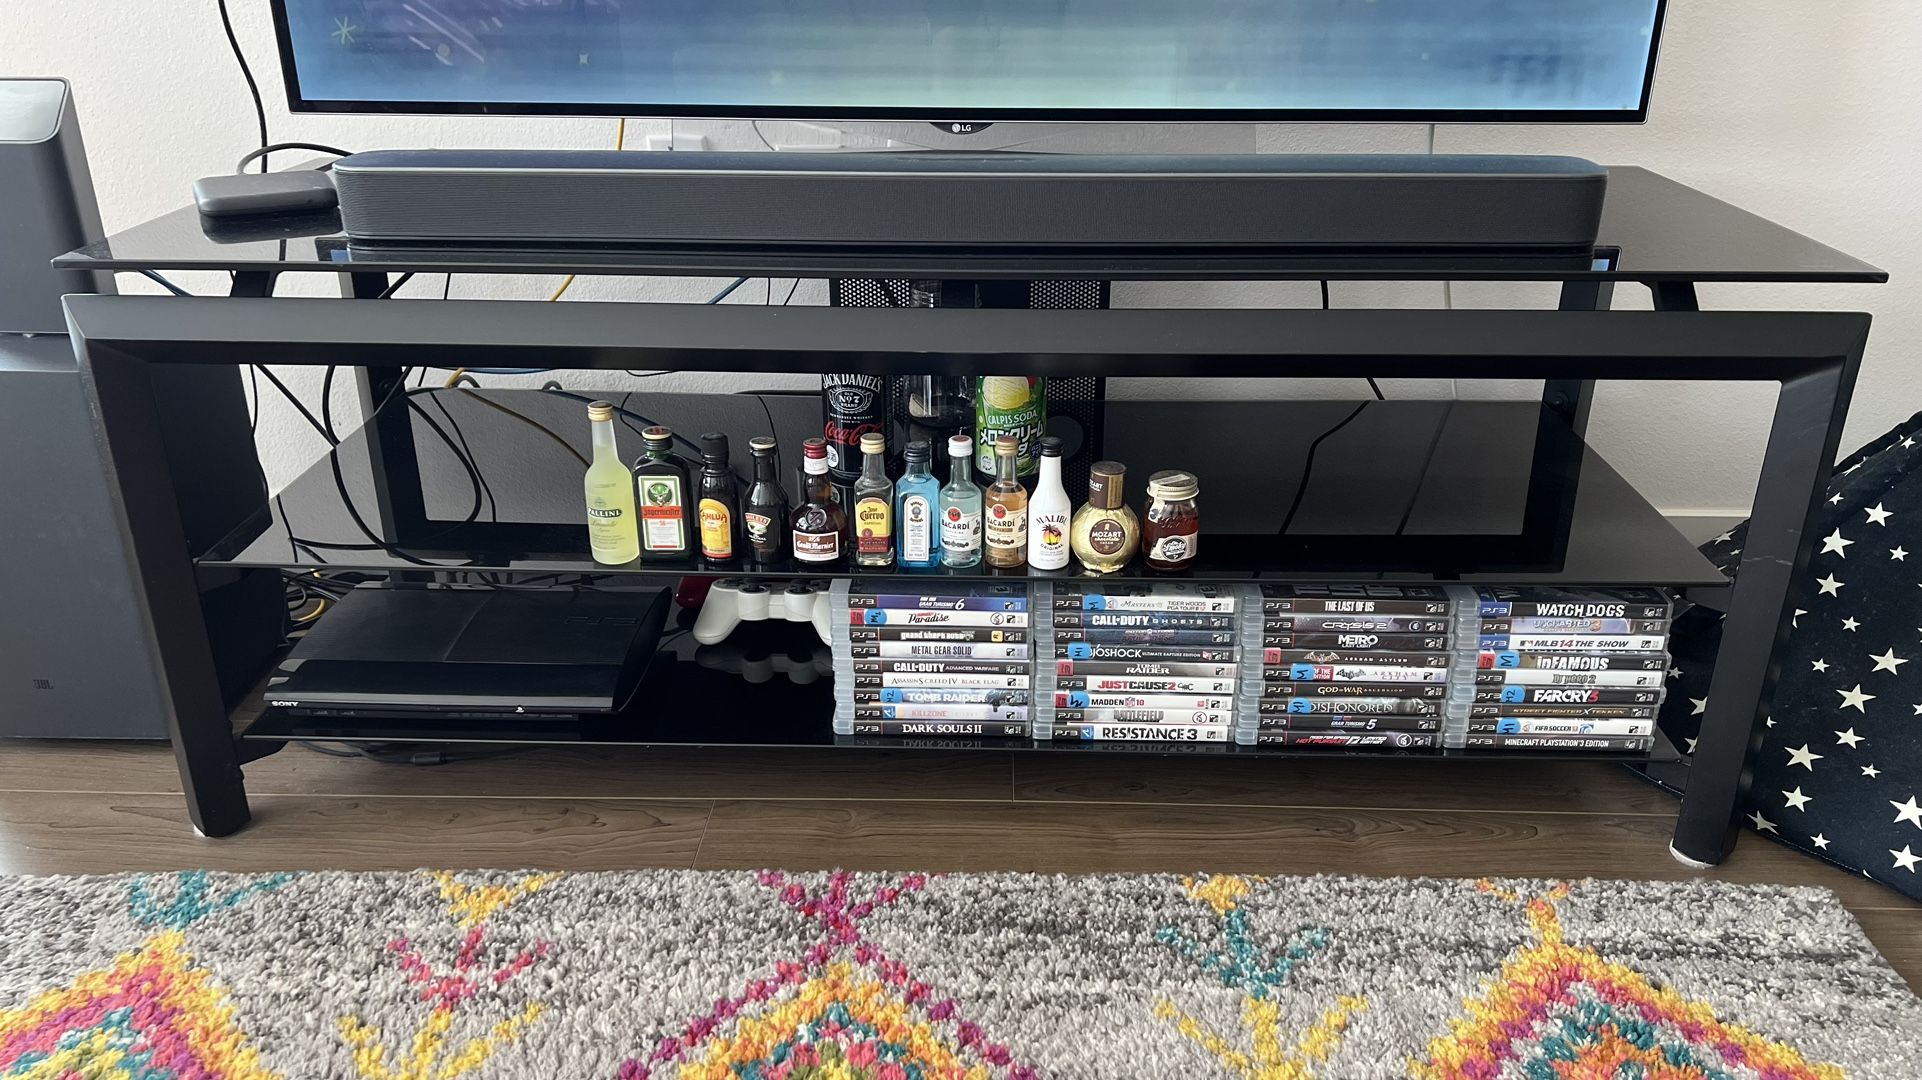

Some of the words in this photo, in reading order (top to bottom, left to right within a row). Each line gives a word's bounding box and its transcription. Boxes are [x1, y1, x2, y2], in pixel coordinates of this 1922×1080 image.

[841, 373, 883, 393] DANIEL'S
[988, 415, 1012, 425] CALPIS
[1013, 409, 1038, 423] SODA
[860, 510, 885, 521] Cuervo
[955, 598, 965, 610] 6
[1324, 601, 1337, 611] THE
[1337, 601, 1355, 611] LAST
[1355, 601, 1365, 611] OF
[1364, 601, 1375, 611] US
[908, 613, 950, 624] Paradise
[1054, 616, 1080, 624] PS3
[1322, 621, 1375, 630] CRYSIS
[1533, 620, 1591, 628] UNCHARTED
[1057, 631, 1083, 639] PS3
[1338, 634, 1378, 645] METRO
[1559, 640, 1574, 648] 14
[911, 646, 932, 655] METAL
[934, 646, 952, 655] GEAR
[953, 646, 972, 656] SOLID
[1536, 656, 1609, 670] inFAMOUS
[32, 679, 55, 690] JBL
[1587, 675, 1597, 684] 2
[1097, 681, 1129, 689] JUST
[1129, 681, 1168, 690] CAUSE
[1317, 686, 1339, 695] GOD
[1343, 686, 1363, 694] WAR
[907, 693, 940, 701] TOMB
[943, 694, 986, 703] RAIDER
[1091, 698, 1124, 706] MADDEN
[902, 724, 934, 733] DARK
[936, 724, 973, 734] SOULS
[973, 724, 983, 733] II
[1366, 719, 1377, 729] 5
[1102, 727, 1186, 739] RESISTANCE
[1186, 728, 1198, 740] 3
[1585, 740, 1609, 748] EDITION
